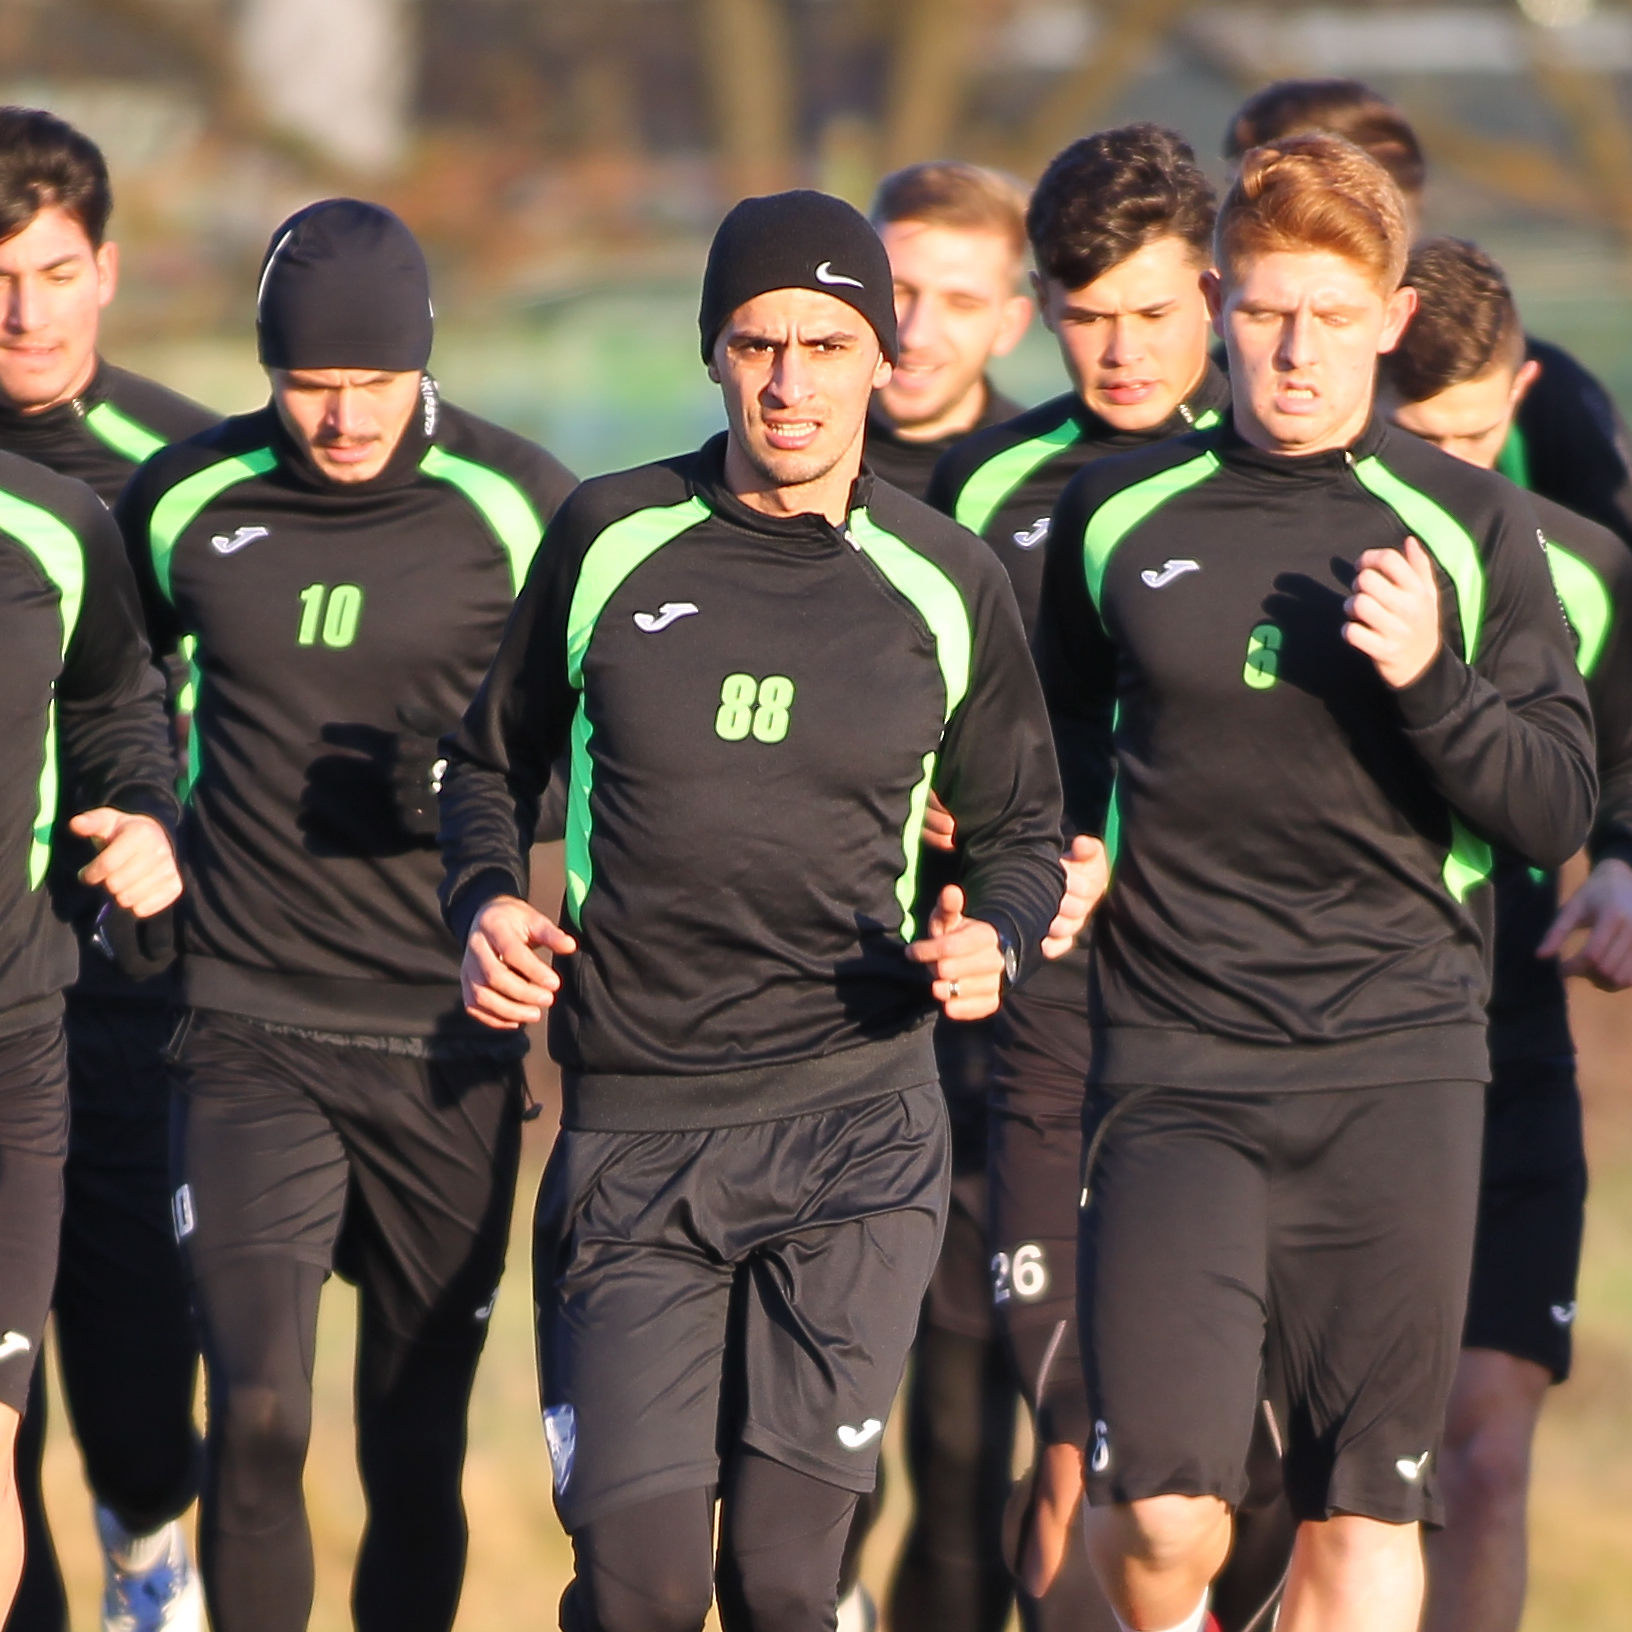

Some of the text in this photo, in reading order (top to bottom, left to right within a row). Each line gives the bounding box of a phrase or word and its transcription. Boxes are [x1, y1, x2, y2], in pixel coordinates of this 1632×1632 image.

[298, 583, 363, 648] 10
[1243, 624, 1284, 690] 6
[715, 673, 796, 744] 88
[172, 1183, 195, 1243] 0
[991, 1244, 1046, 1305] 26
